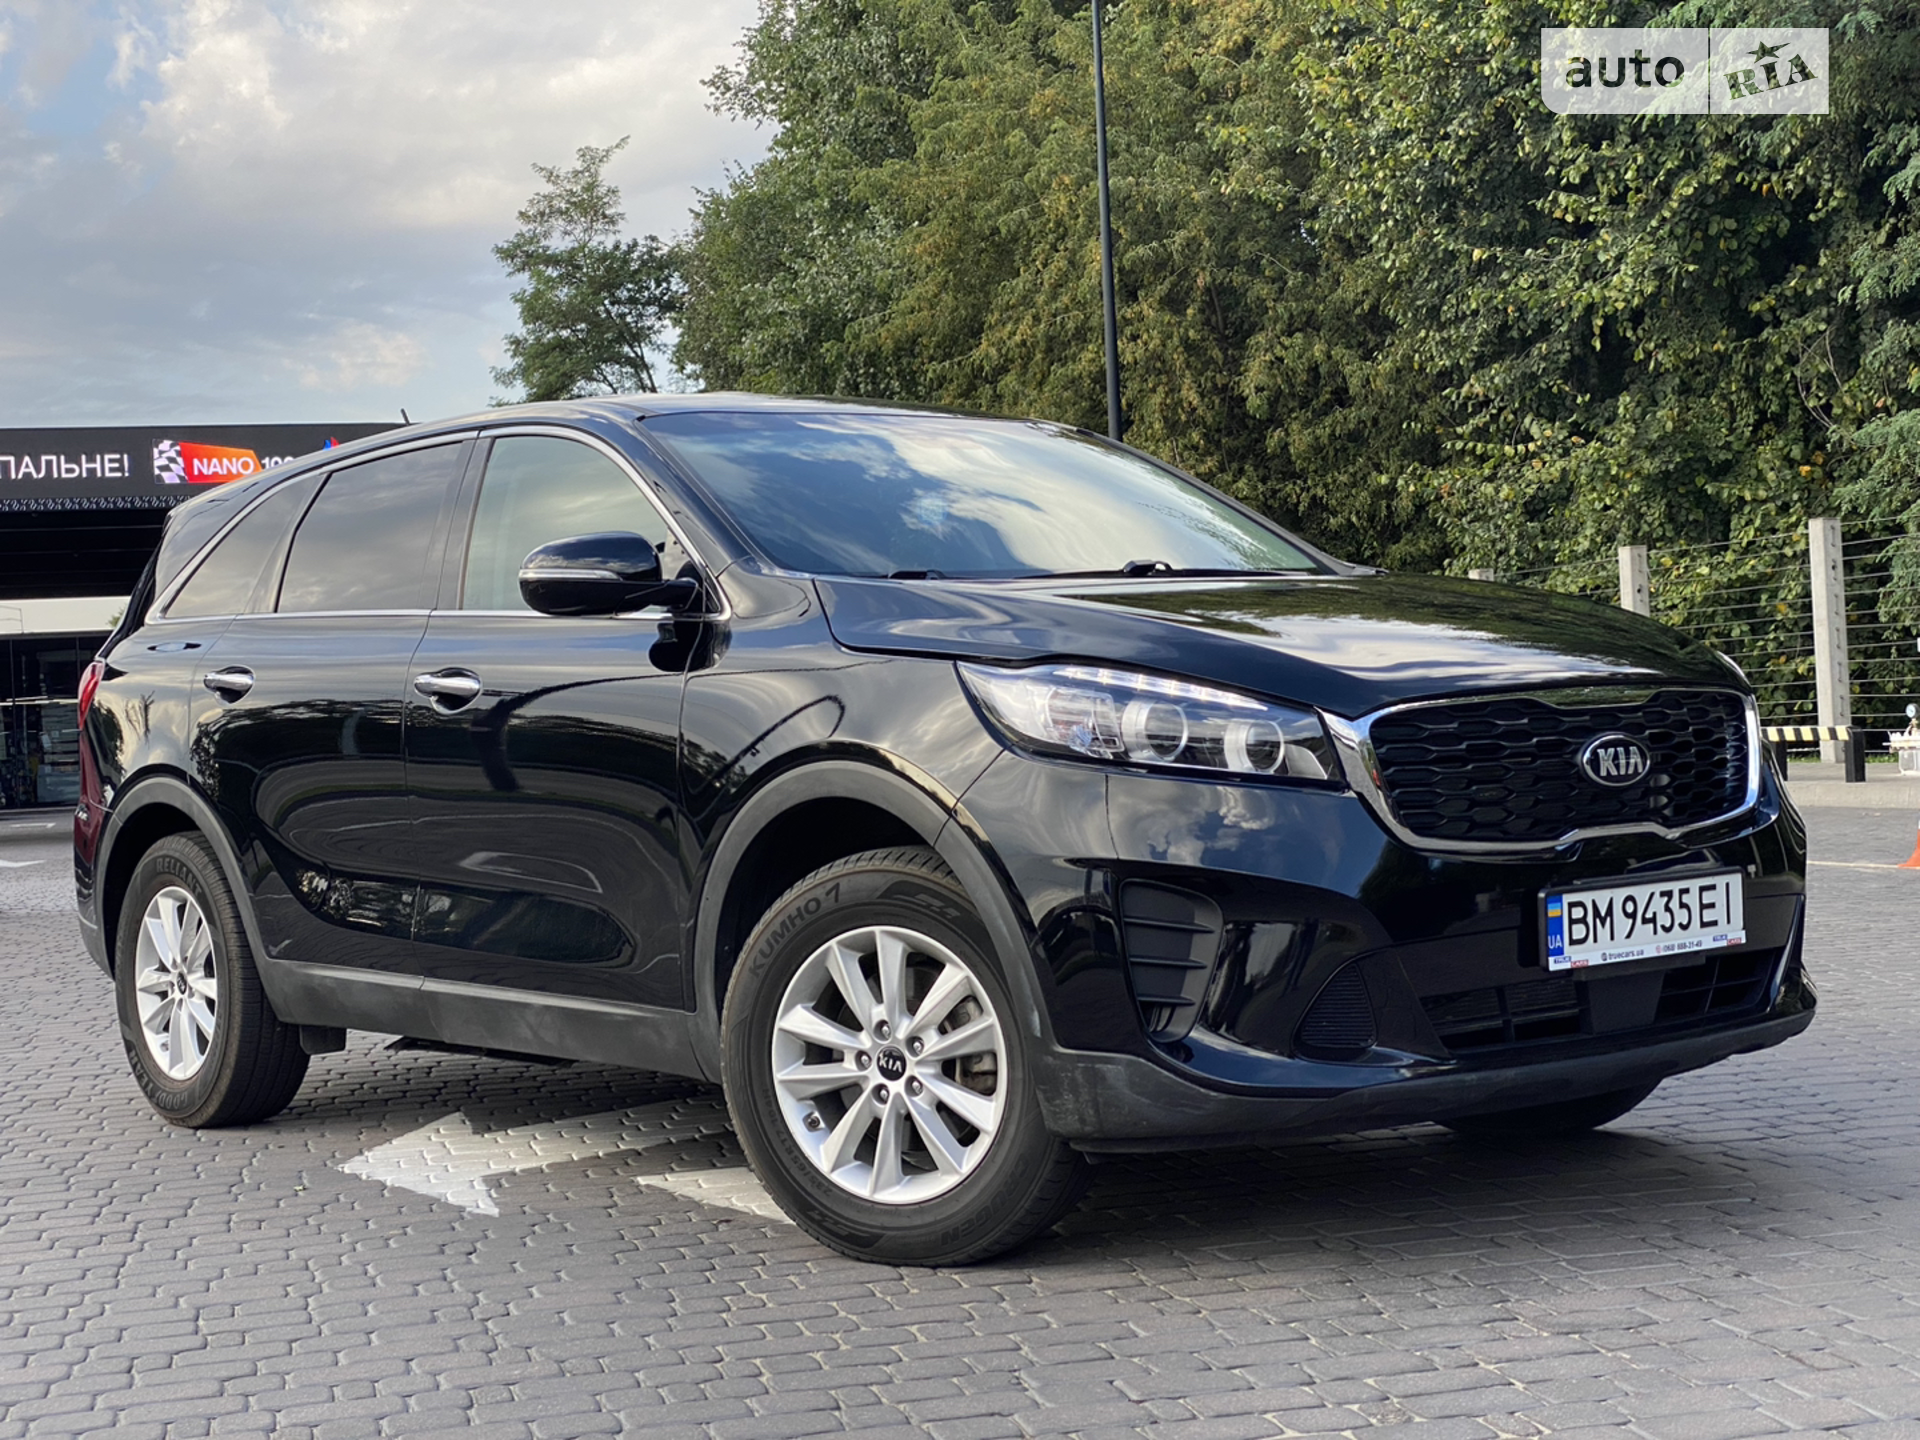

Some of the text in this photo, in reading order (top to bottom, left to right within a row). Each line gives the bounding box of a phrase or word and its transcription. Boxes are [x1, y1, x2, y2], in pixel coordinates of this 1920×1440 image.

[0, 453, 130, 480] ПАЛЬНЕ!
[192, 456, 255, 476] NANO
[1596, 746, 1644, 777] KIA
[748, 896, 822, 979] KUMHO
[1547, 933, 1564, 950] UA
[878, 1052, 903, 1073] KIA
